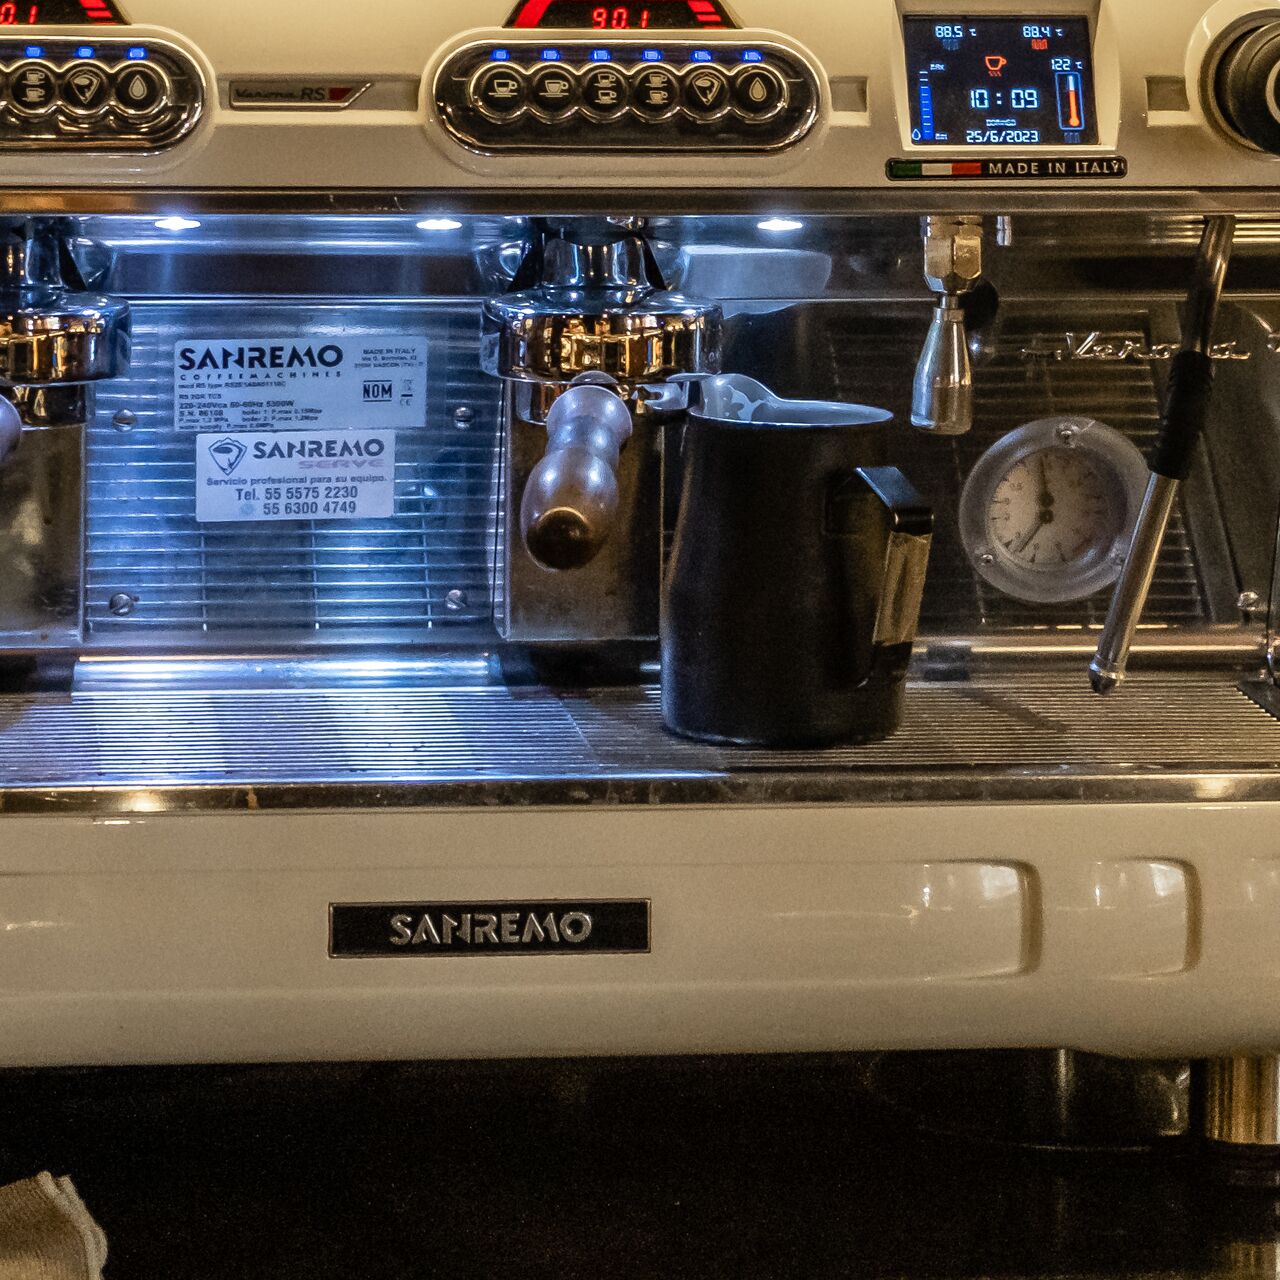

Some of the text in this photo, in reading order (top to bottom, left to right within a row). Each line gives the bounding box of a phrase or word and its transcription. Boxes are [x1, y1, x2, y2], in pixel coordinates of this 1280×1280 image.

[935, 25, 963, 38] 88.5
[1022, 25, 1051, 38] 88.4
[1051, 58, 1071, 71] 122
[301, 86, 326, 101] RS
[966, 129, 1039, 144] 25/6/2023
[988, 160, 1119, 174] MADE IN ITALY
[1066, 331, 1251, 360] Veroa
[179, 344, 343, 371] SANREMO
[363, 384, 392, 398] NOM
[252, 438, 385, 459] SANREMO
[206, 477, 248, 486] Servicio
[250, 476, 307, 486] profesional
[310, 476, 333, 486] para
[350, 475, 388, 485] equipo.
[236, 485, 359, 501] Tel. 55 5575 2230
[263, 500, 357, 515] 55 6300 4749
[388, 910, 593, 946] SANREMO
